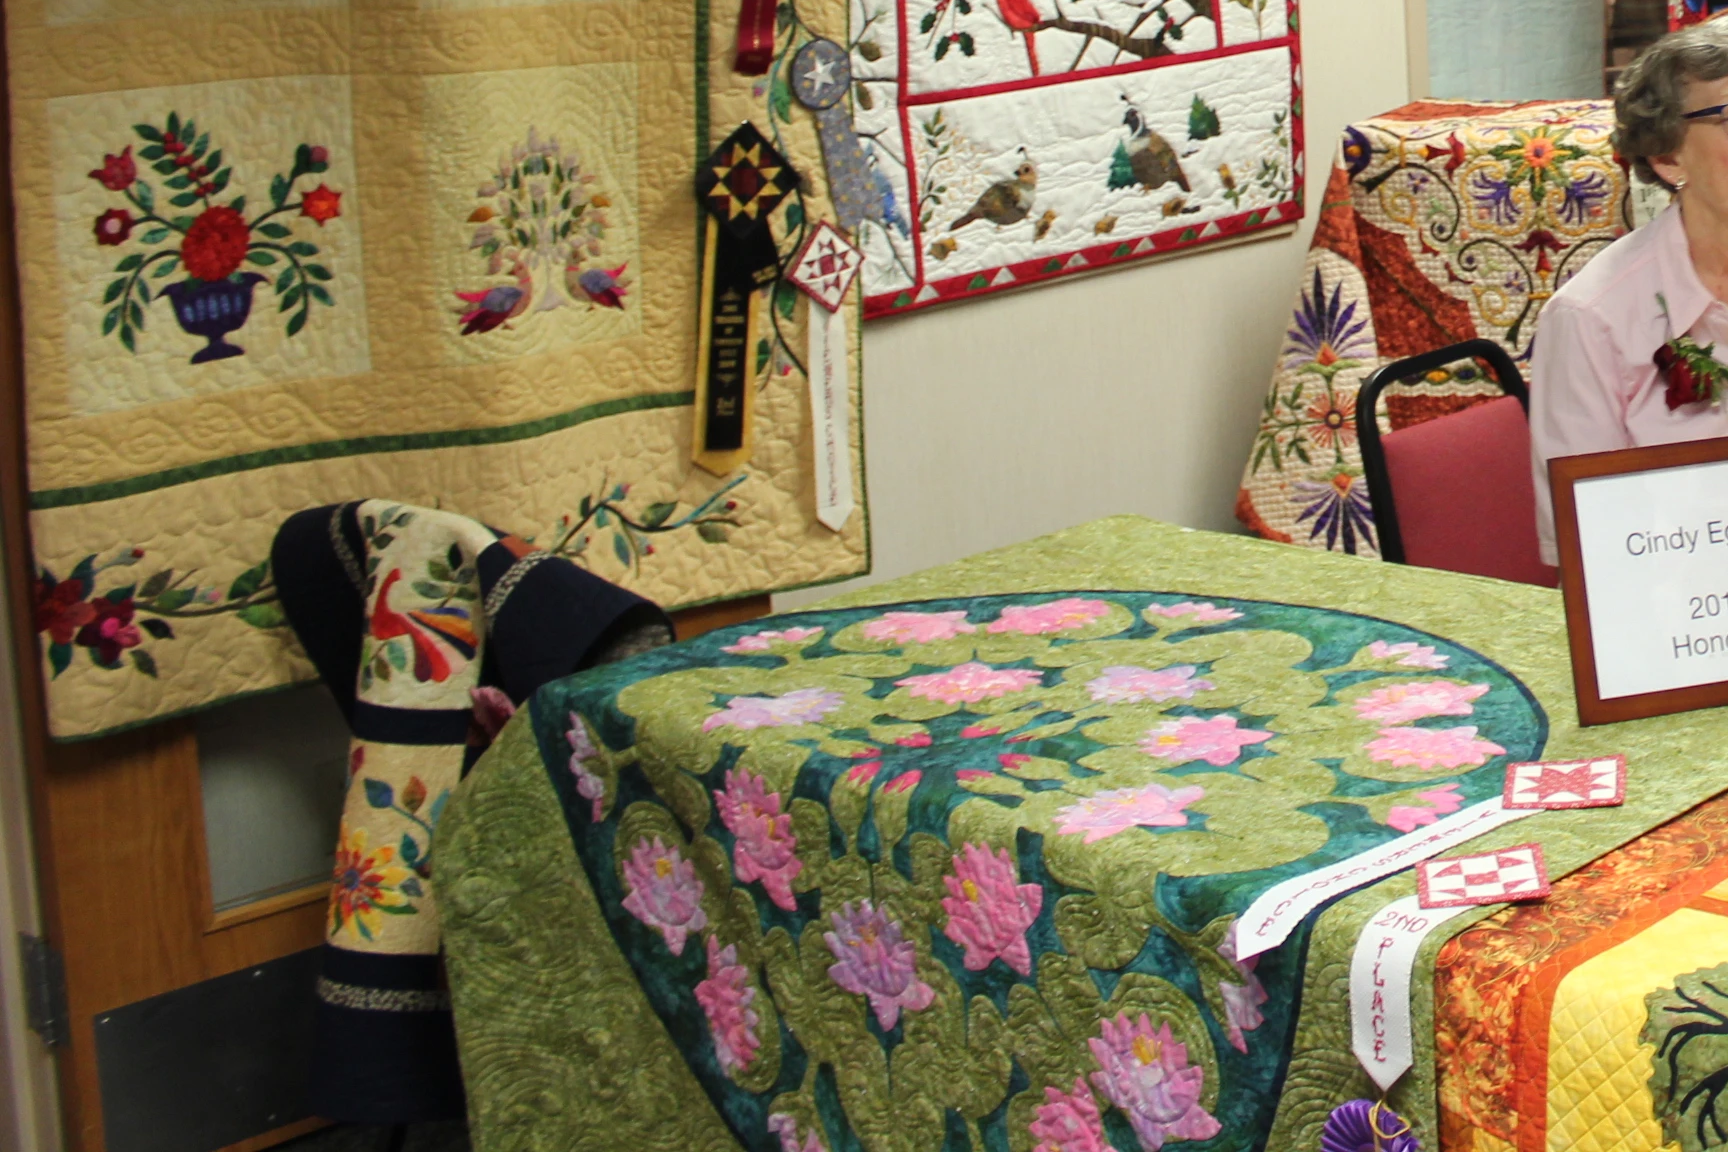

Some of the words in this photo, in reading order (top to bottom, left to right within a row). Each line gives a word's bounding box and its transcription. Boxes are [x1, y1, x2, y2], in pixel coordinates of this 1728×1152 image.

[1626, 527, 1699, 556] Cindy
[1372, 809, 1497, 868] VIEWERS
[1256, 866, 1367, 937] CHOICE
[1374, 911, 1428, 933] 2ND
[1371, 936, 1394, 1063] PLACE
